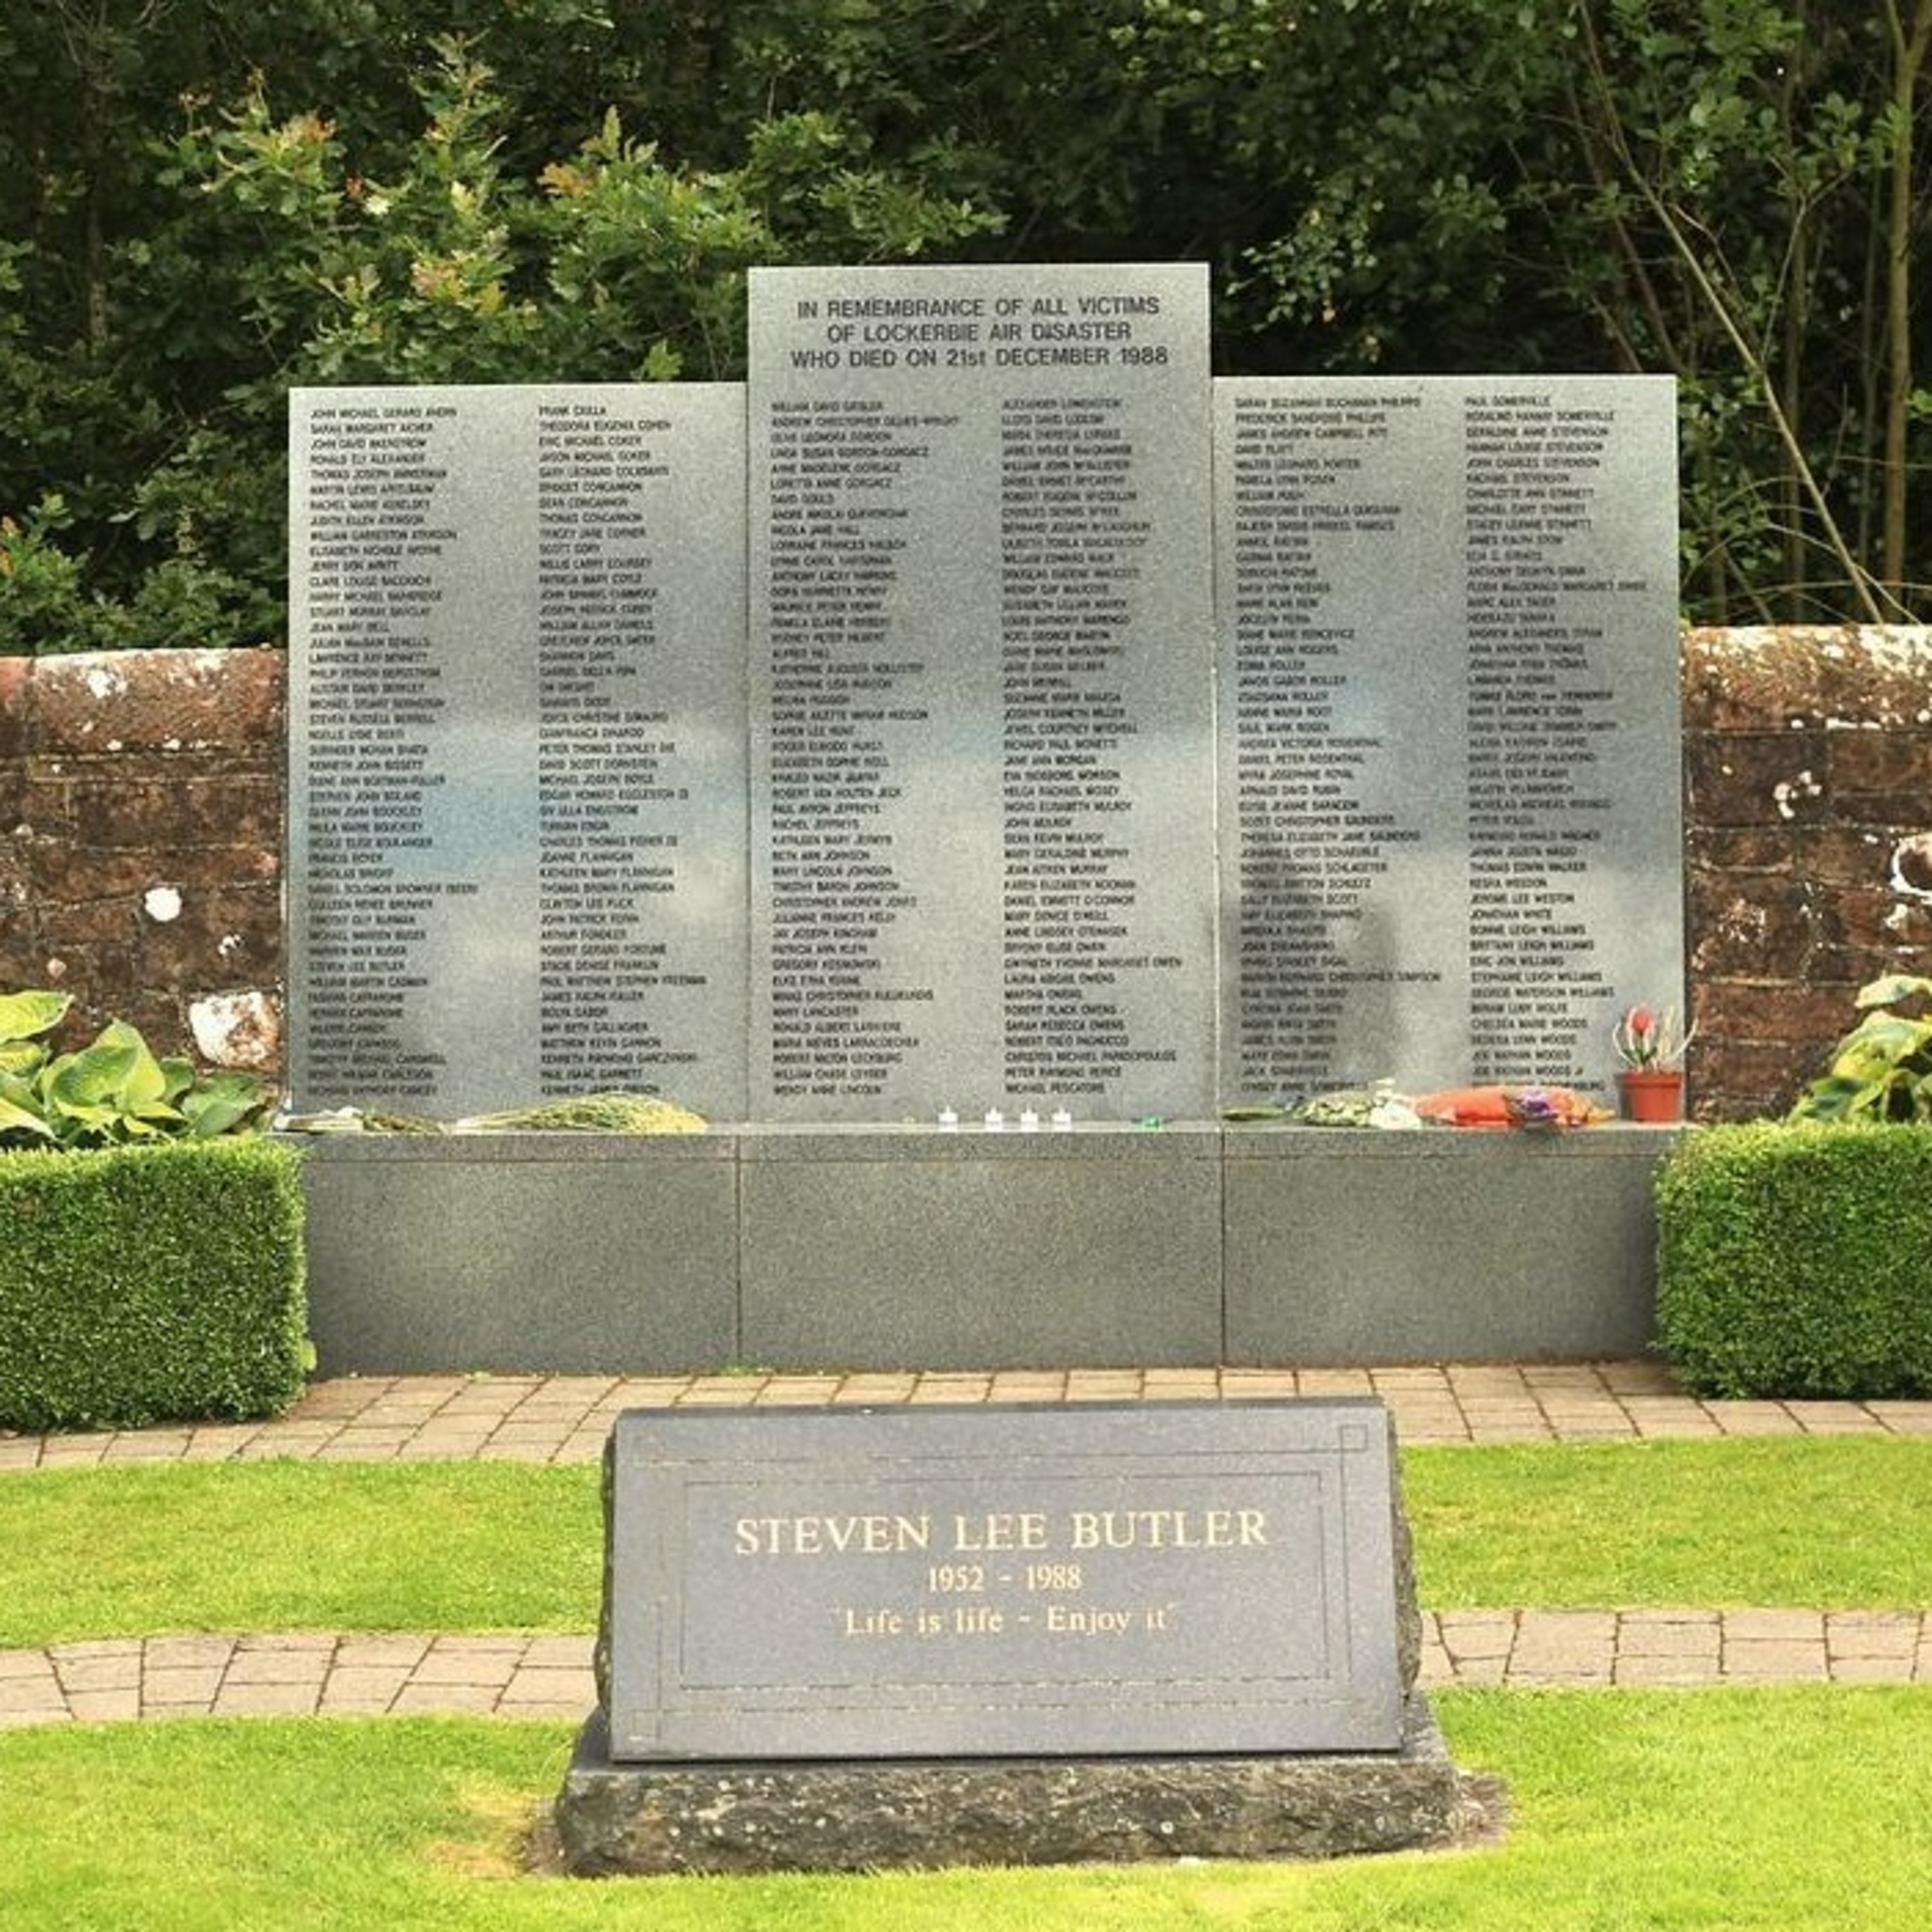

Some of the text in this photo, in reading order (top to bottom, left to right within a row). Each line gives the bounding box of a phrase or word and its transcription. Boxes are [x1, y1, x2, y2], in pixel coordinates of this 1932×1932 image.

[797, 296, 1160, 320] IN REMEMBRANCE OF ALL VICTIMS
[827, 321, 1132, 343] OF LOCKERBIE AIR DISASTER
[790, 346, 1169, 368] WHO DIED ON 21st DECEMBER 1988
[735, 1510, 1270, 1555] STEVEN LEE BUTLER
[927, 1566, 985, 1592] 1952
[1027, 1565, 1083, 1591] 1988
[918, 1607, 942, 1633] is
[956, 1606, 1004, 1633] life
[1046, 1606, 1132, 1636] Enjoy
